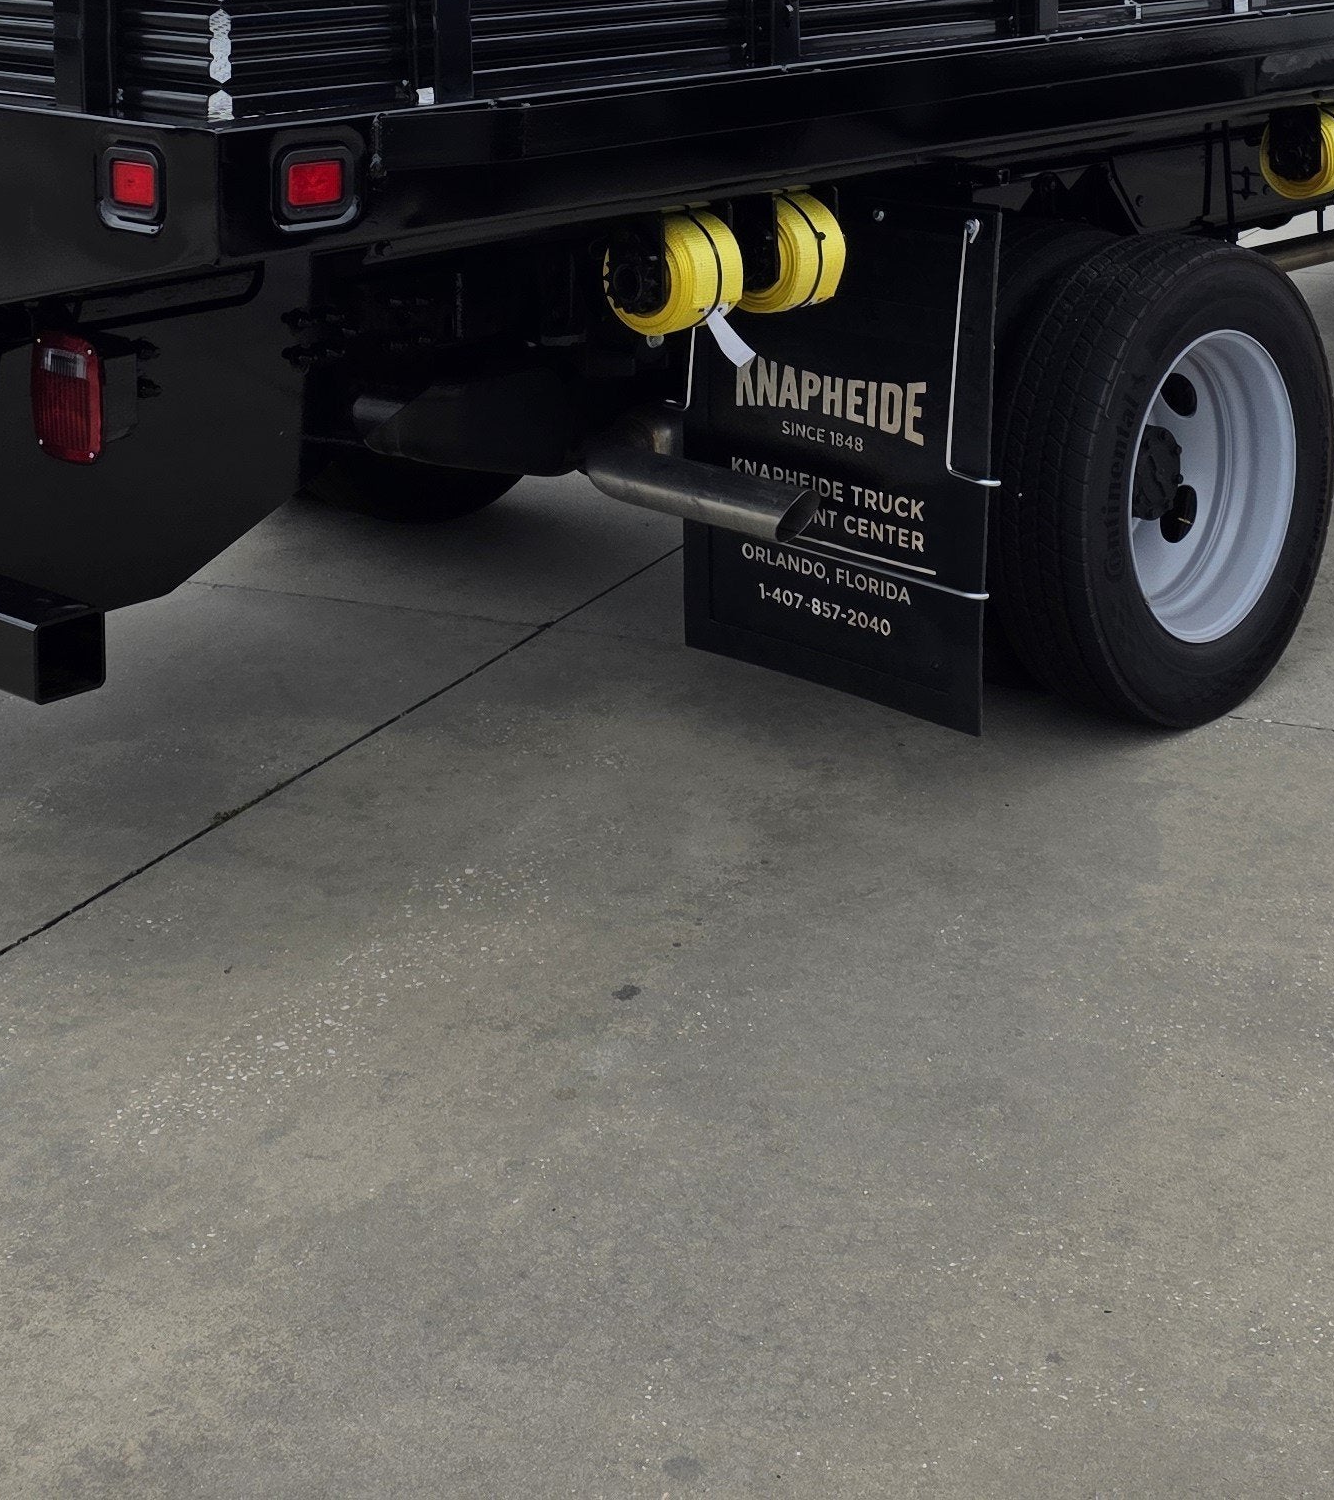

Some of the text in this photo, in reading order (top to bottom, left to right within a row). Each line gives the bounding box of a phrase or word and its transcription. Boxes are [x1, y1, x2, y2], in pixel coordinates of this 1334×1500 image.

[735, 354, 927, 447] KNAPHEIDE
[781, 420, 865, 452] SINCE 1848
[850, 485, 925, 522] TRUCK
[843, 514, 925, 553] CENTER
[741, 542, 912, 606] ORLANDO, FLORIDA
[758, 582, 892, 637] 1-407-857-2040
